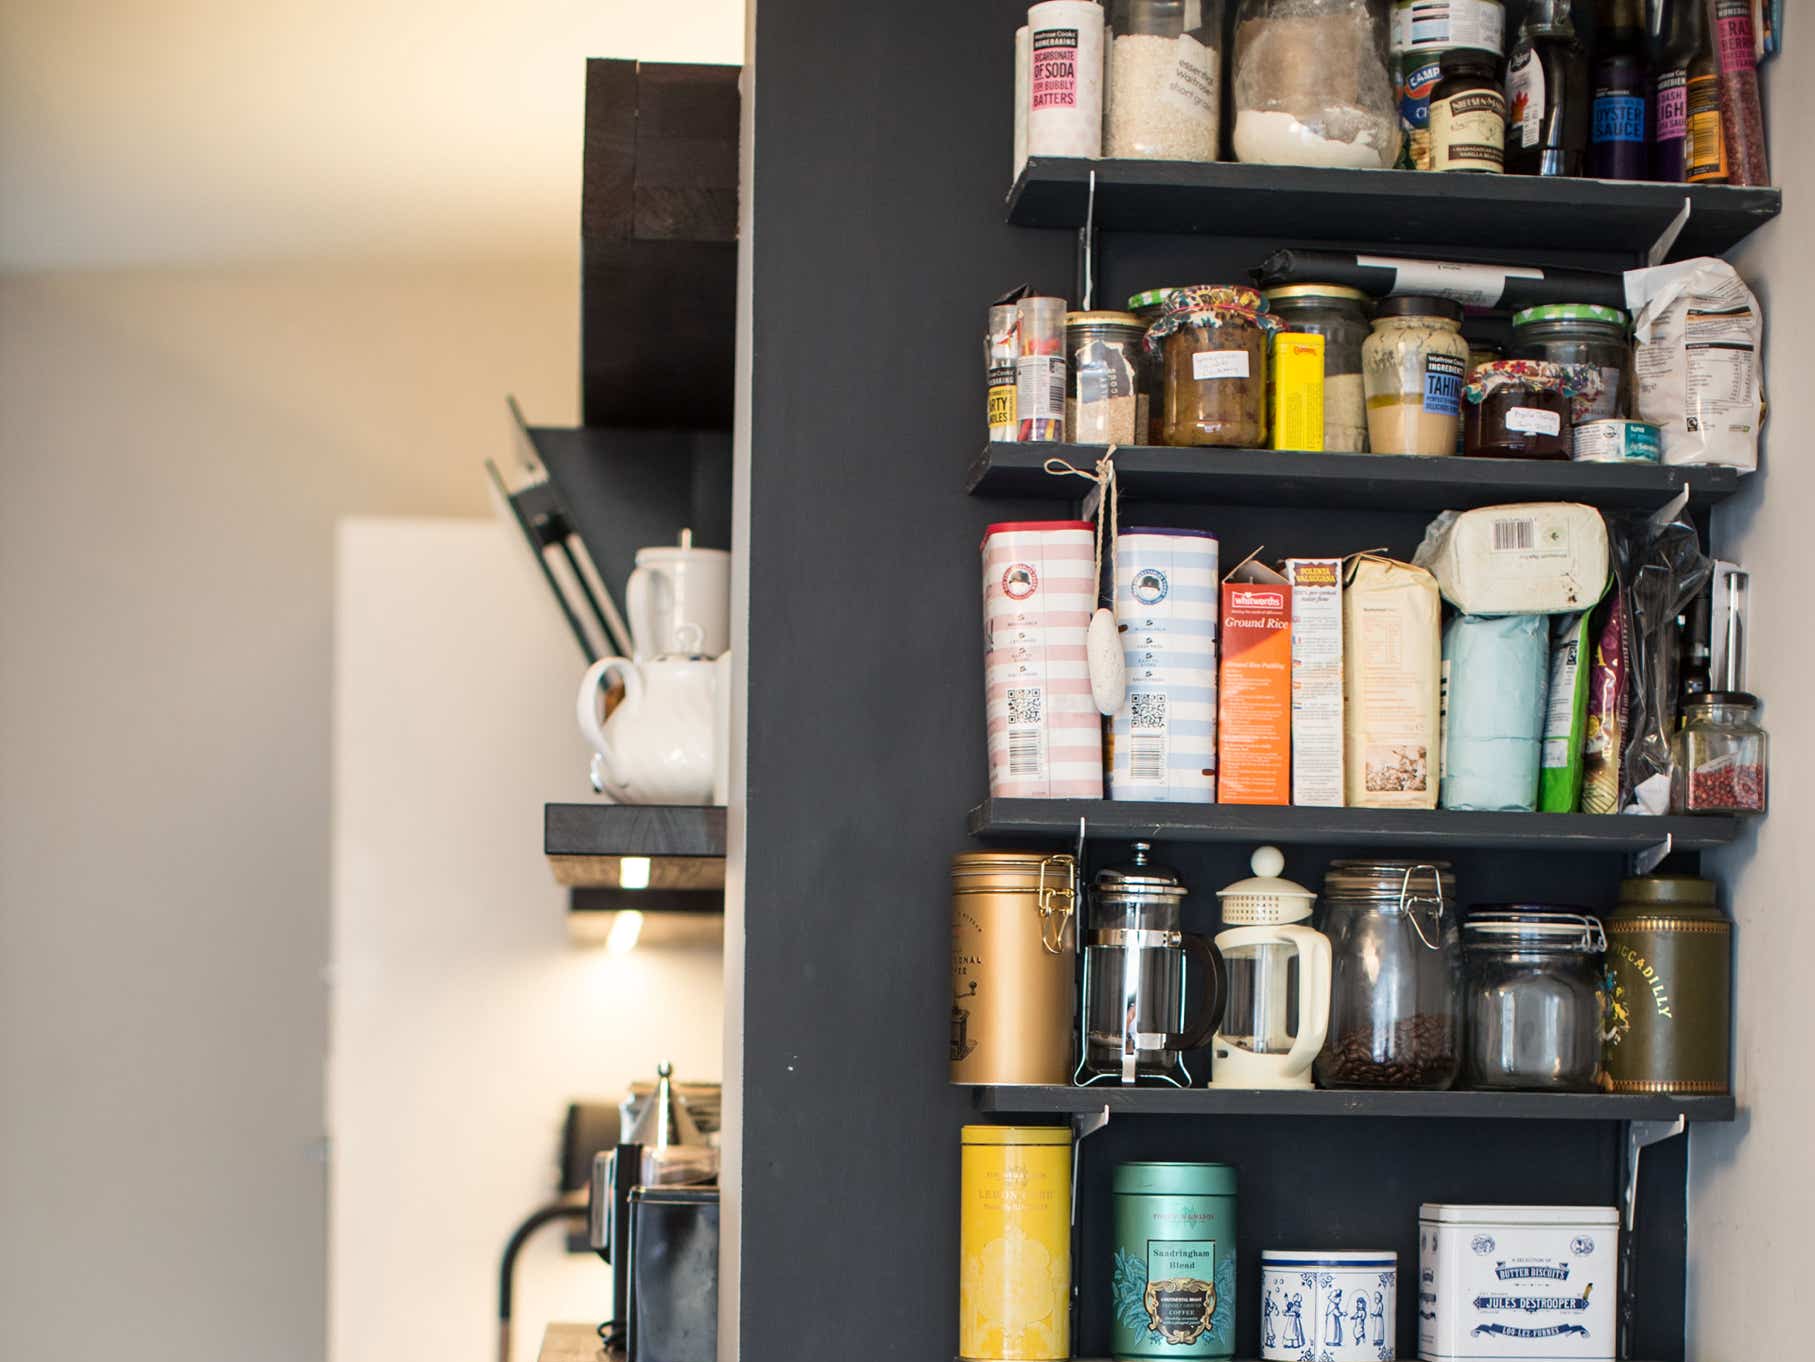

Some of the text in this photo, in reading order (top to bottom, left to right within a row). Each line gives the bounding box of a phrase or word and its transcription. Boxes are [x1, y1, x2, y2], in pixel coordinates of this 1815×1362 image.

[1034, 51, 1074, 63] BICARBONATE
[1034, 62, 1074, 79] OF SODA
[1410, 67, 1441, 86] CAMP
[1045, 80, 1074, 91] BUBBLY
[1033, 93, 1074, 107] BATTERS
[1598, 121, 1641, 137] SAUCE
[1225, 616, 1288, 630] Ground Rice
[1153, 1249, 1210, 1258] Sandringham
[1169, 1261, 1195, 1269] Blend
[1500, 1268, 1565, 1280] BUTTER BISCUITS
[1486, 1298, 1576, 1309] JULES DESTROOPER
